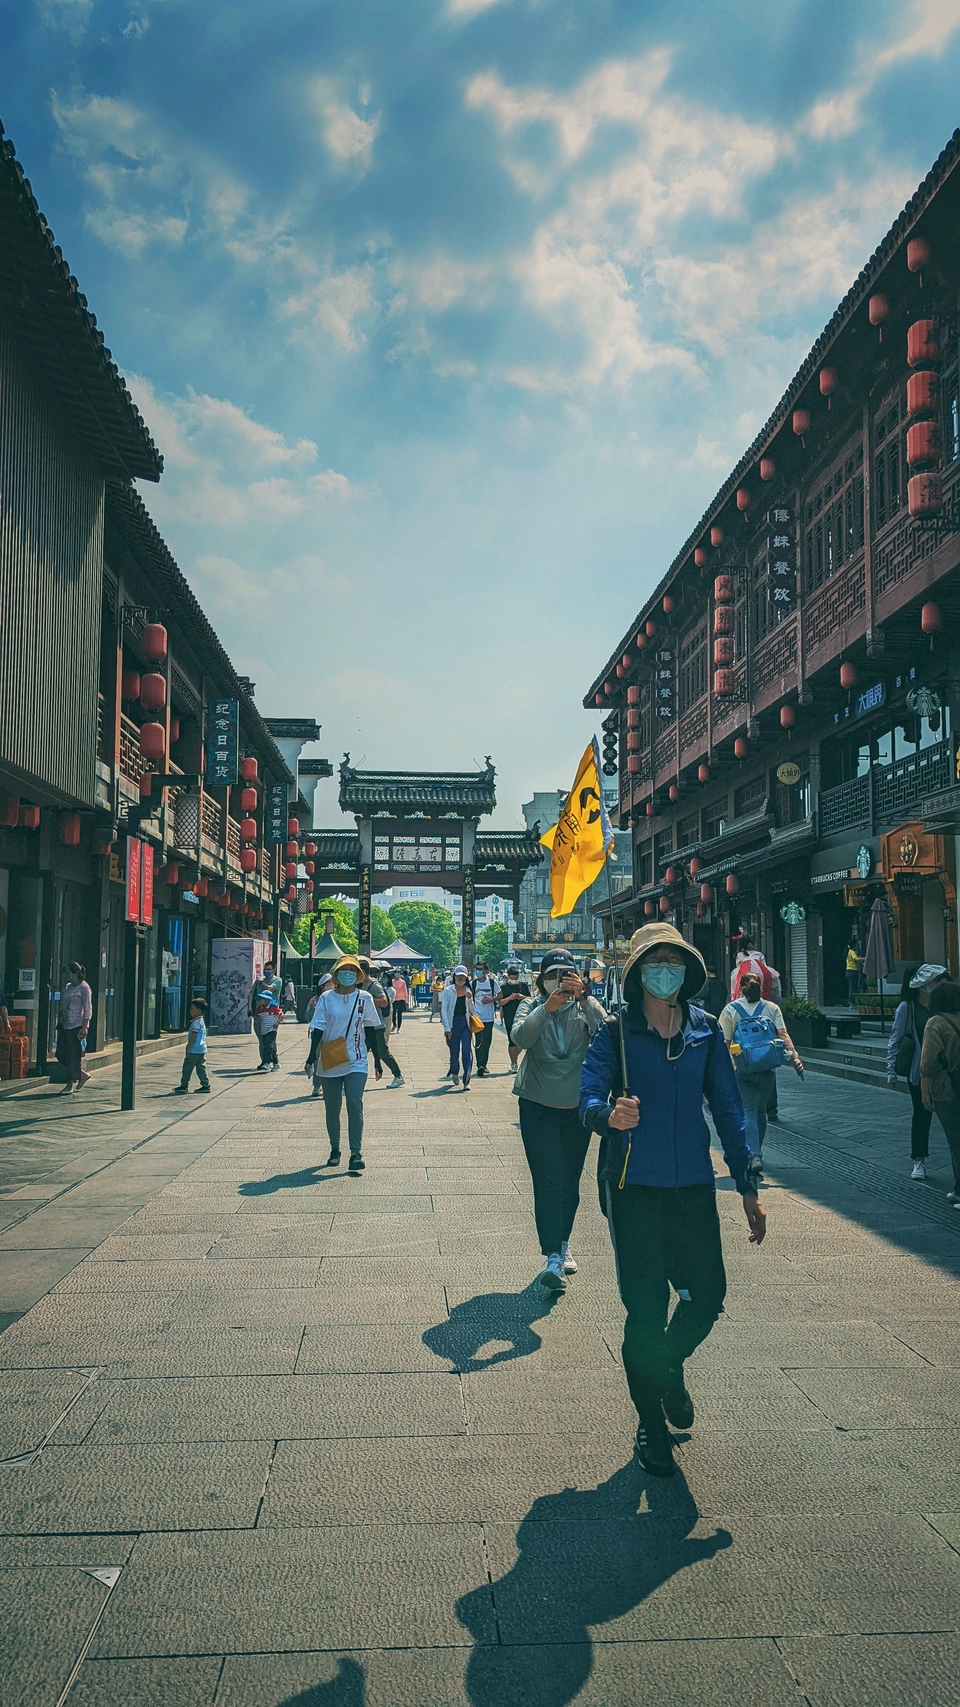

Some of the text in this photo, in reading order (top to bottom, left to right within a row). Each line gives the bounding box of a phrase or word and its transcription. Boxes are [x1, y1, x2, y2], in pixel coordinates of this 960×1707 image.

[773, 509, 791, 602] 傣妹餐饮
[215, 703, 230, 777] 纪念日百货
[272, 786, 282, 838] 纪念日百货
[810, 869, 848, 885] STARBUCKS COFFEE
